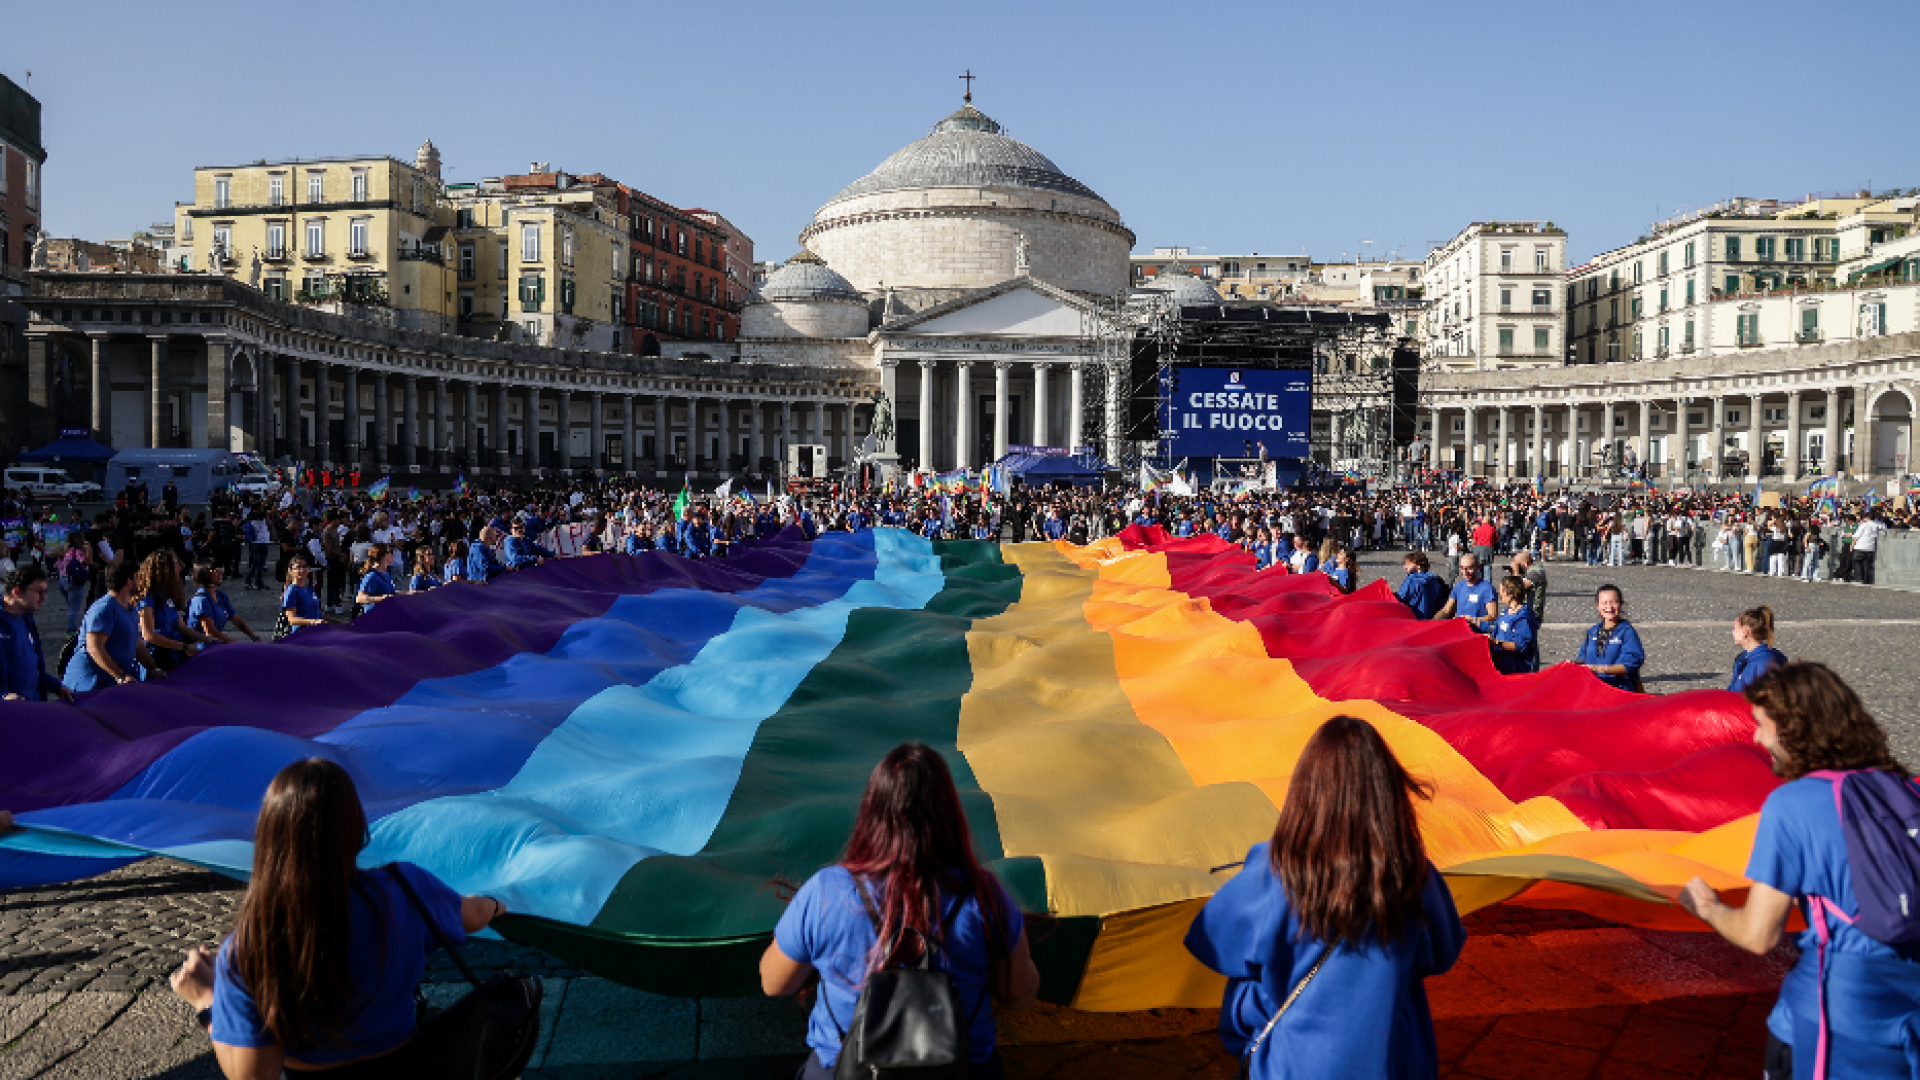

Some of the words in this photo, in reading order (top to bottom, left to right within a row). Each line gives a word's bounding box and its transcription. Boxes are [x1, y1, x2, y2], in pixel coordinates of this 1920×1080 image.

[1189, 392, 1279, 410] CESSATE
[1183, 413, 1203, 429] IL
[1210, 413, 1283, 430] FUOCO
